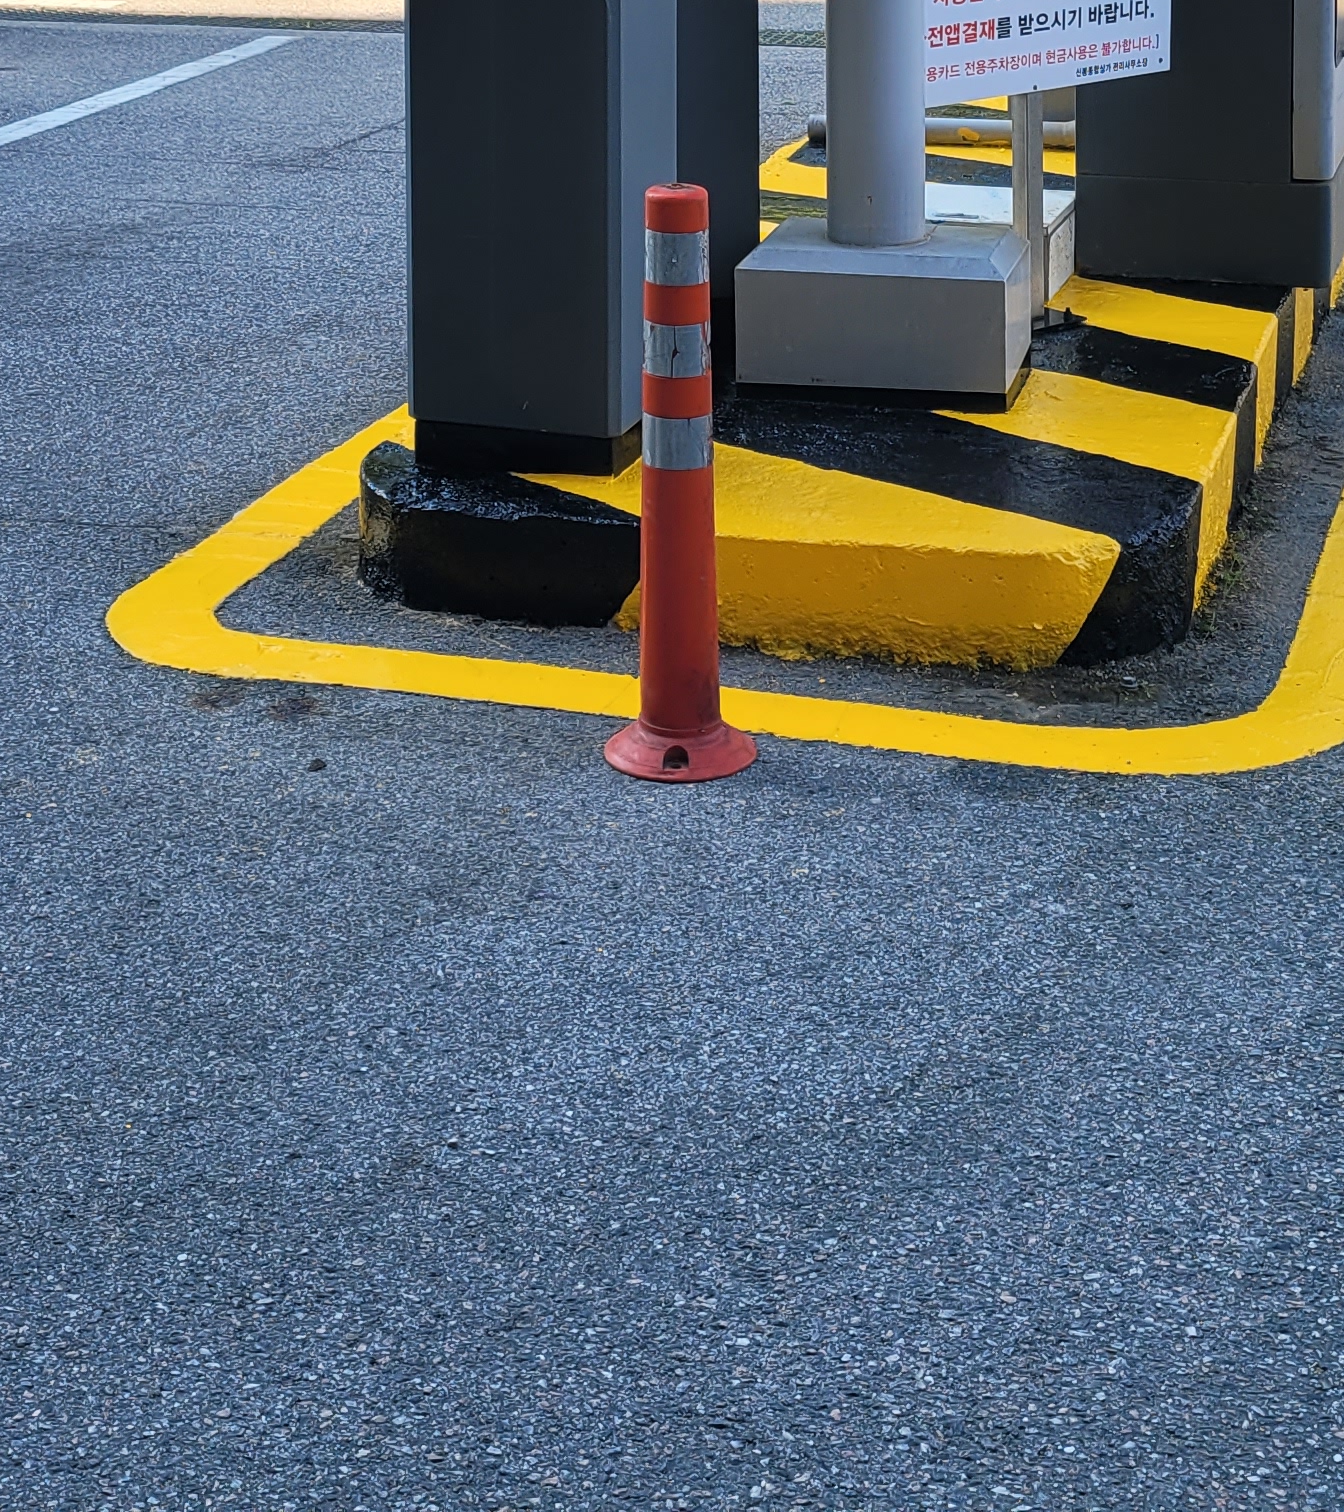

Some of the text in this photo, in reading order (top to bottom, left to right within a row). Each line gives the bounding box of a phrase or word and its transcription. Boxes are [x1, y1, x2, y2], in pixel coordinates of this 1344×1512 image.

[924, 16, 1012, 48] 전앱결재를
[1018, 6, 1083, 37] 받으시기
[965, 52, 1042, 76] 전용주차장이며
[1046, 44, 1098, 65] 현금사용은
